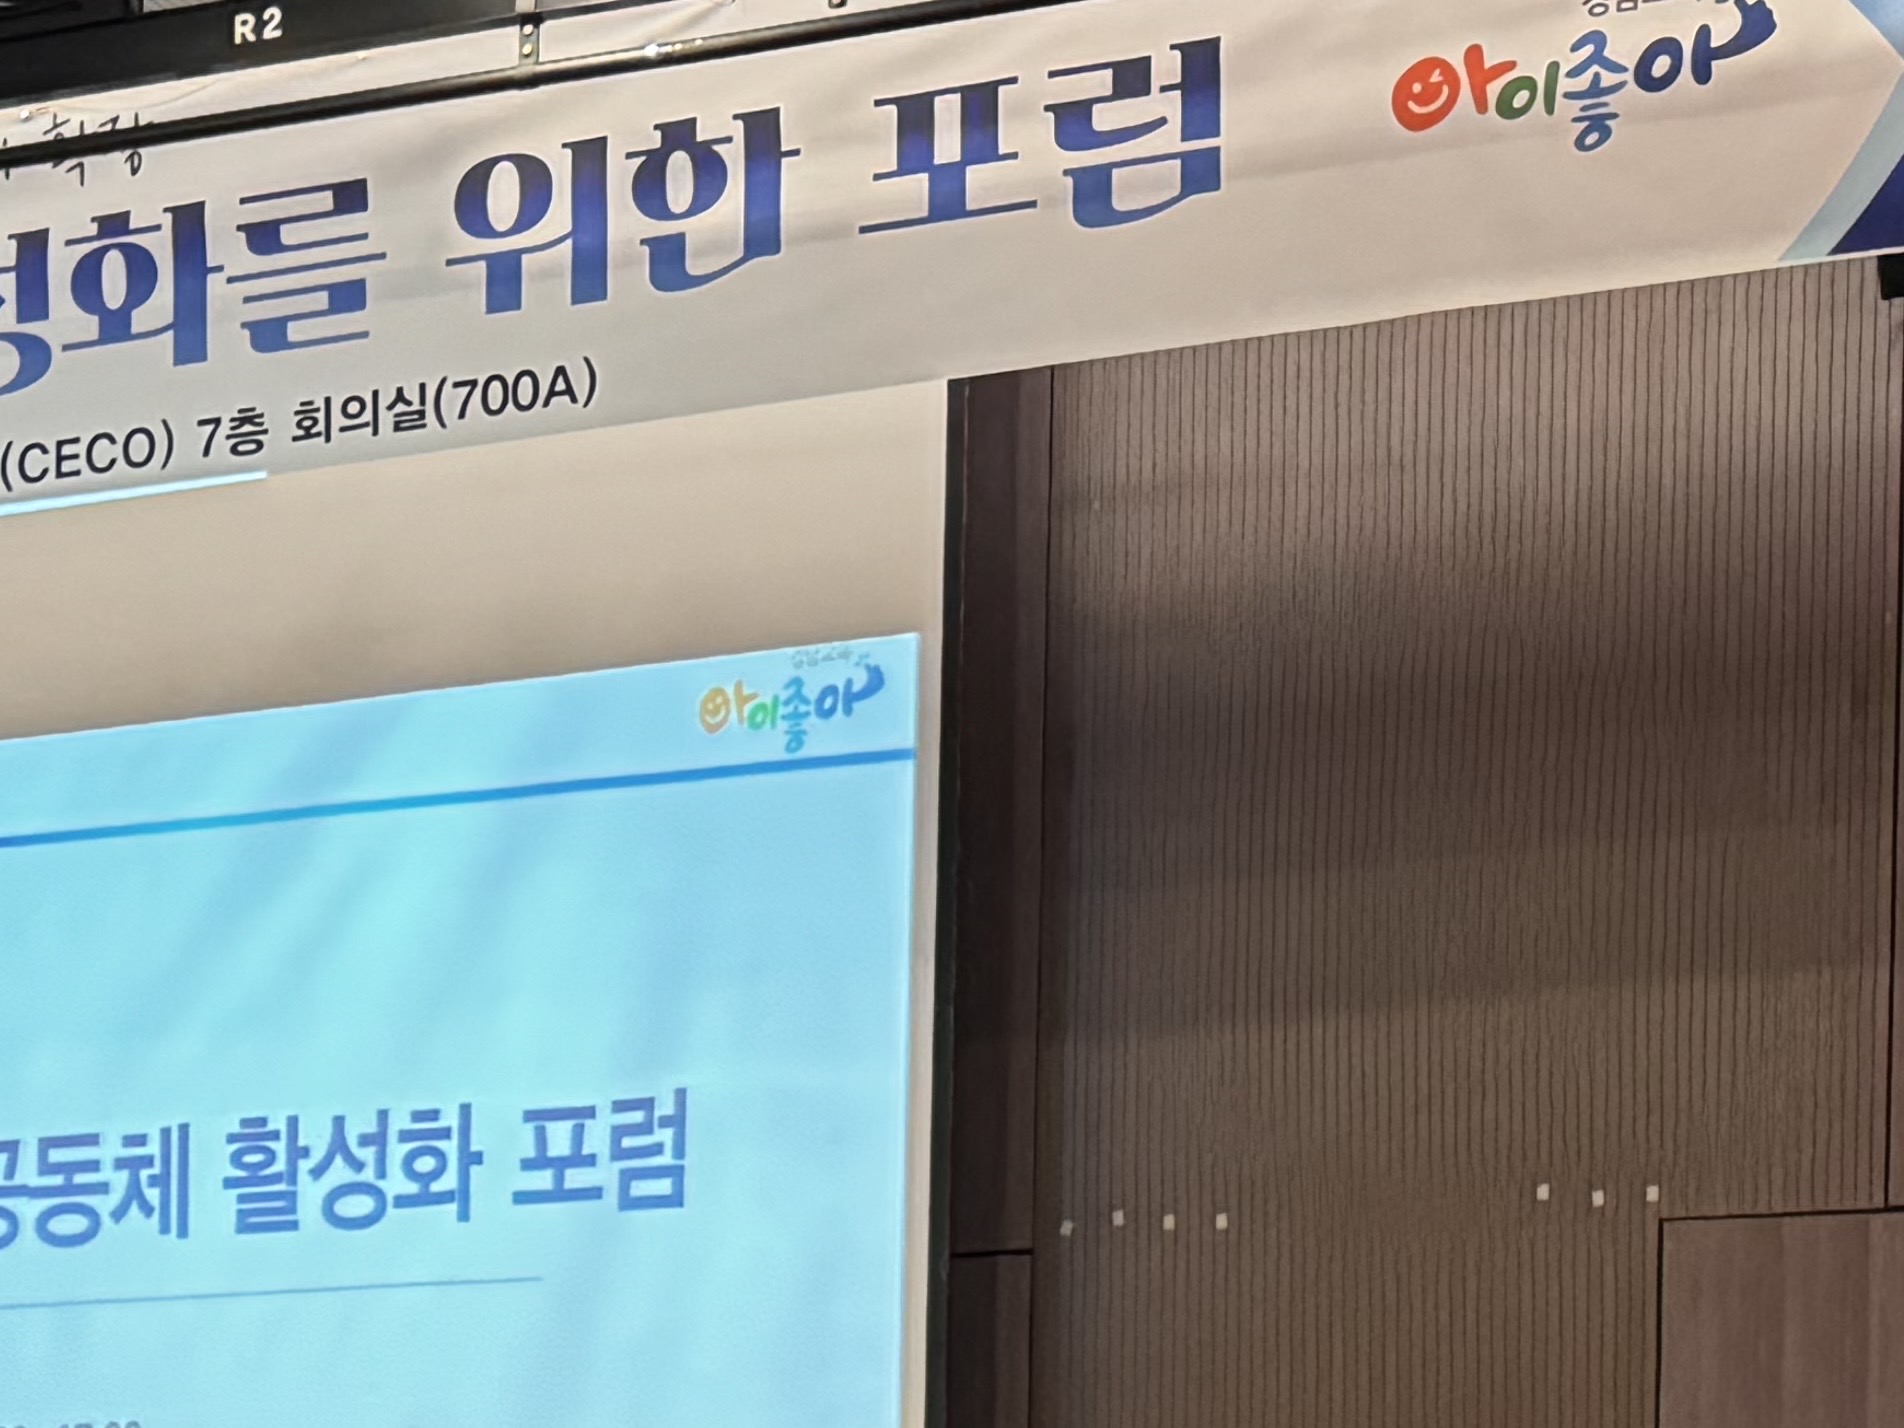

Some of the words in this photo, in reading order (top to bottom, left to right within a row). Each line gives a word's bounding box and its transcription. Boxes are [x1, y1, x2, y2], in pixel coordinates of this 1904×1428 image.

[445, 106, 801, 315] 위한
[858, 35, 1222, 235] 포럼
[196, 406, 269, 459] 7층
[291, 356, 598, 444] 회의실(700A)
[222, 1101, 484, 1235] 활성화
[512, 1087, 689, 1213] 포럼
